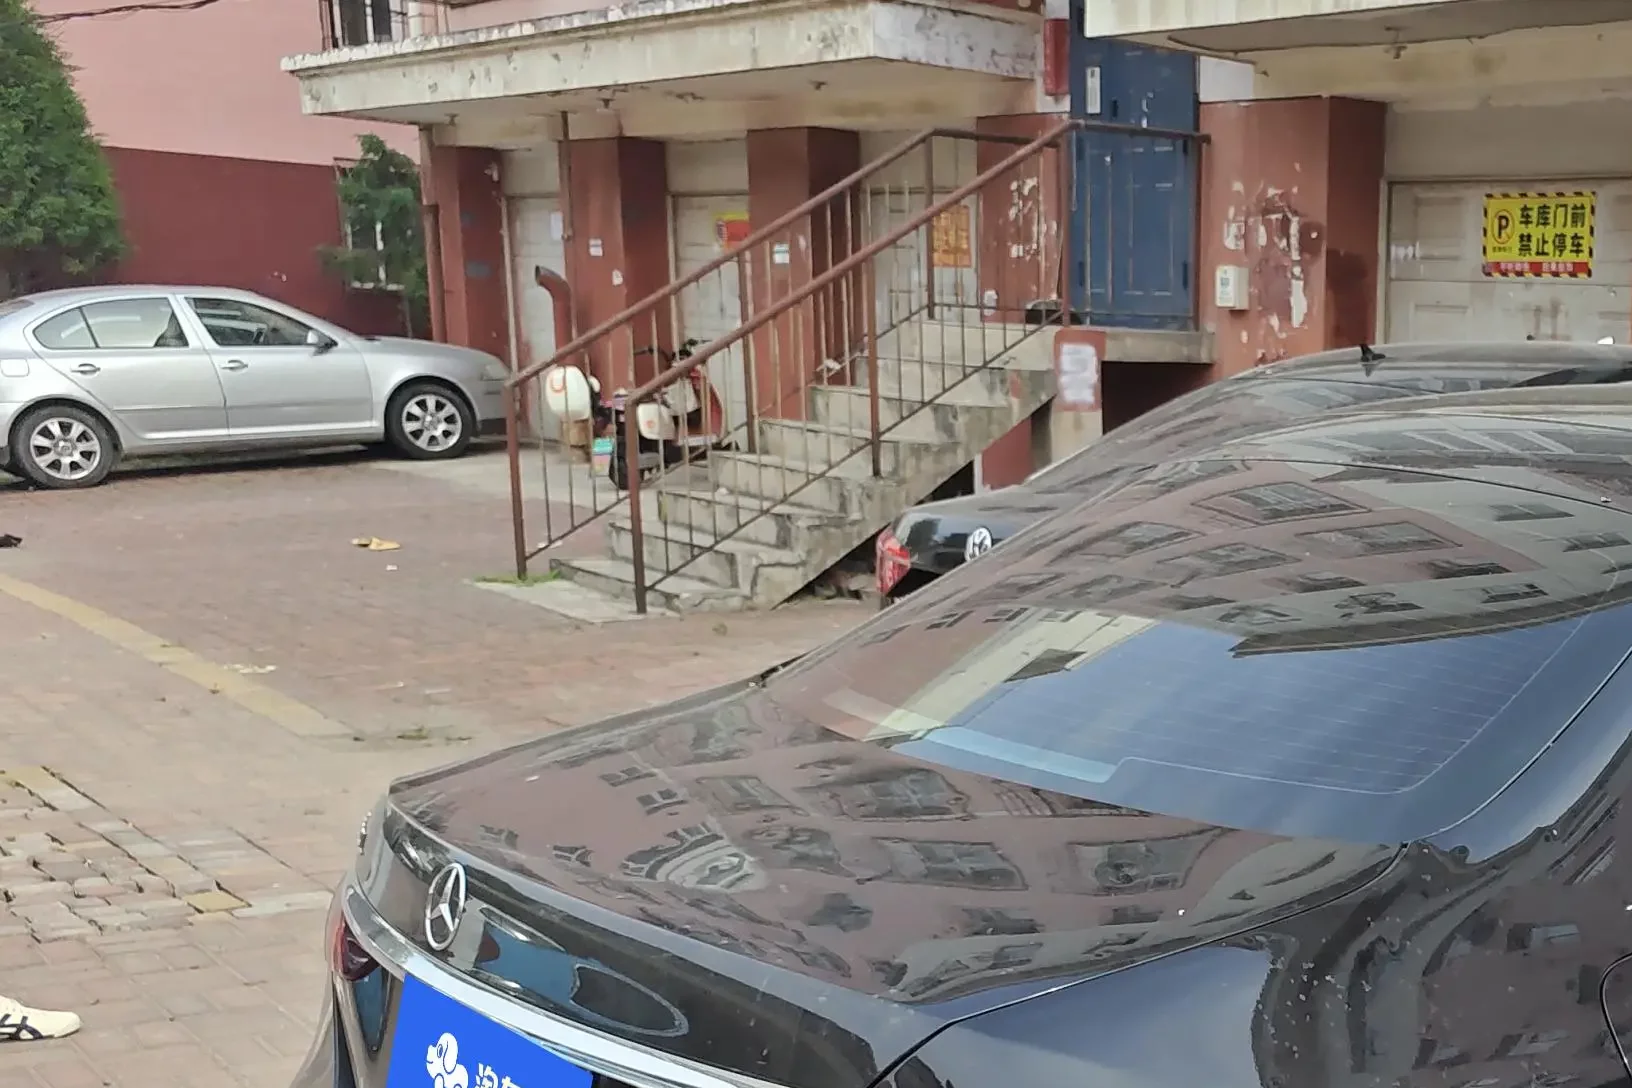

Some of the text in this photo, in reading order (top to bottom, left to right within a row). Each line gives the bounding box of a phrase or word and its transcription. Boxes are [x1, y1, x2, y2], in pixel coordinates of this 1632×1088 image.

[1519, 203, 1586, 229] 车库门前
[1518, 232, 1585, 258] 禁止停车
